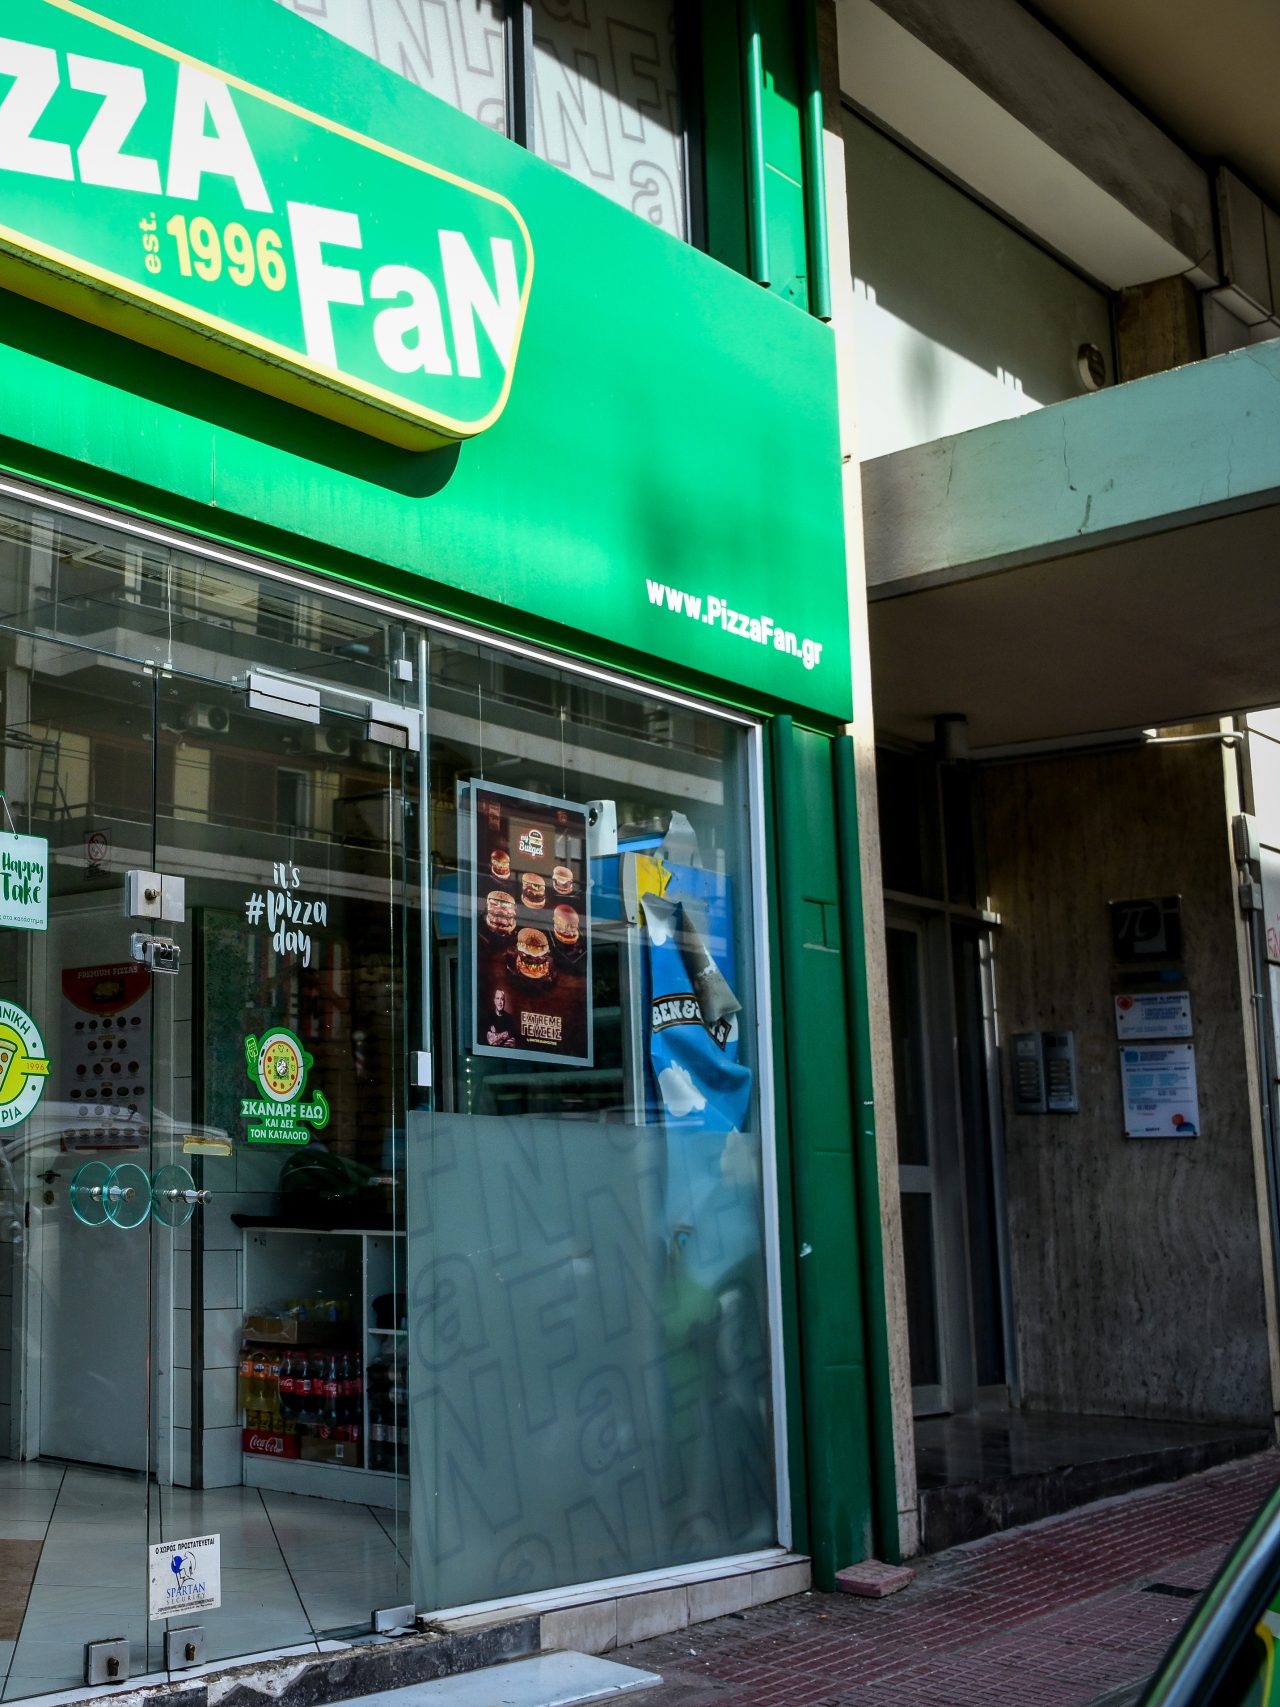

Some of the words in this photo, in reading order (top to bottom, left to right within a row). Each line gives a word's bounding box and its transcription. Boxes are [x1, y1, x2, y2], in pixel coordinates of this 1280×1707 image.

[139, 212, 162, 274] est.
[166, 214, 287, 292] 1996
[286, 200, 522, 378] FaN
[645, 578, 822, 670] www.PizzaFan.gr
[2, 852, 44, 883] Happy
[273, 860, 300, 889] it's
[0, 872, 41, 905] Take
[272, 919, 311, 968] day
[521, 1011, 562, 1027] EXTREME
[26, 1062, 45, 1071] 1996
[241, 1100, 297, 1118] ΣΚΑΝΑΡΕ
[300, 1105, 323, 1119] ΕΔΩ
[265, 1118, 279, 1128] ΚΑΙ
[280, 1119, 294, 1128] ΔΕΣ
[250, 1129, 266, 1139] ΤΟΝ
[268, 1130, 308, 1140] ΚΑΤΑΛΟΓΟ
[160, 1544, 176, 1554] ΧΩΡΟΣ
[177, 1538, 215, 1551] ΠΡΟΣΤΑΤΕΥΕΤΑΙ
[166, 1581, 206, 1599] SPARTAN
